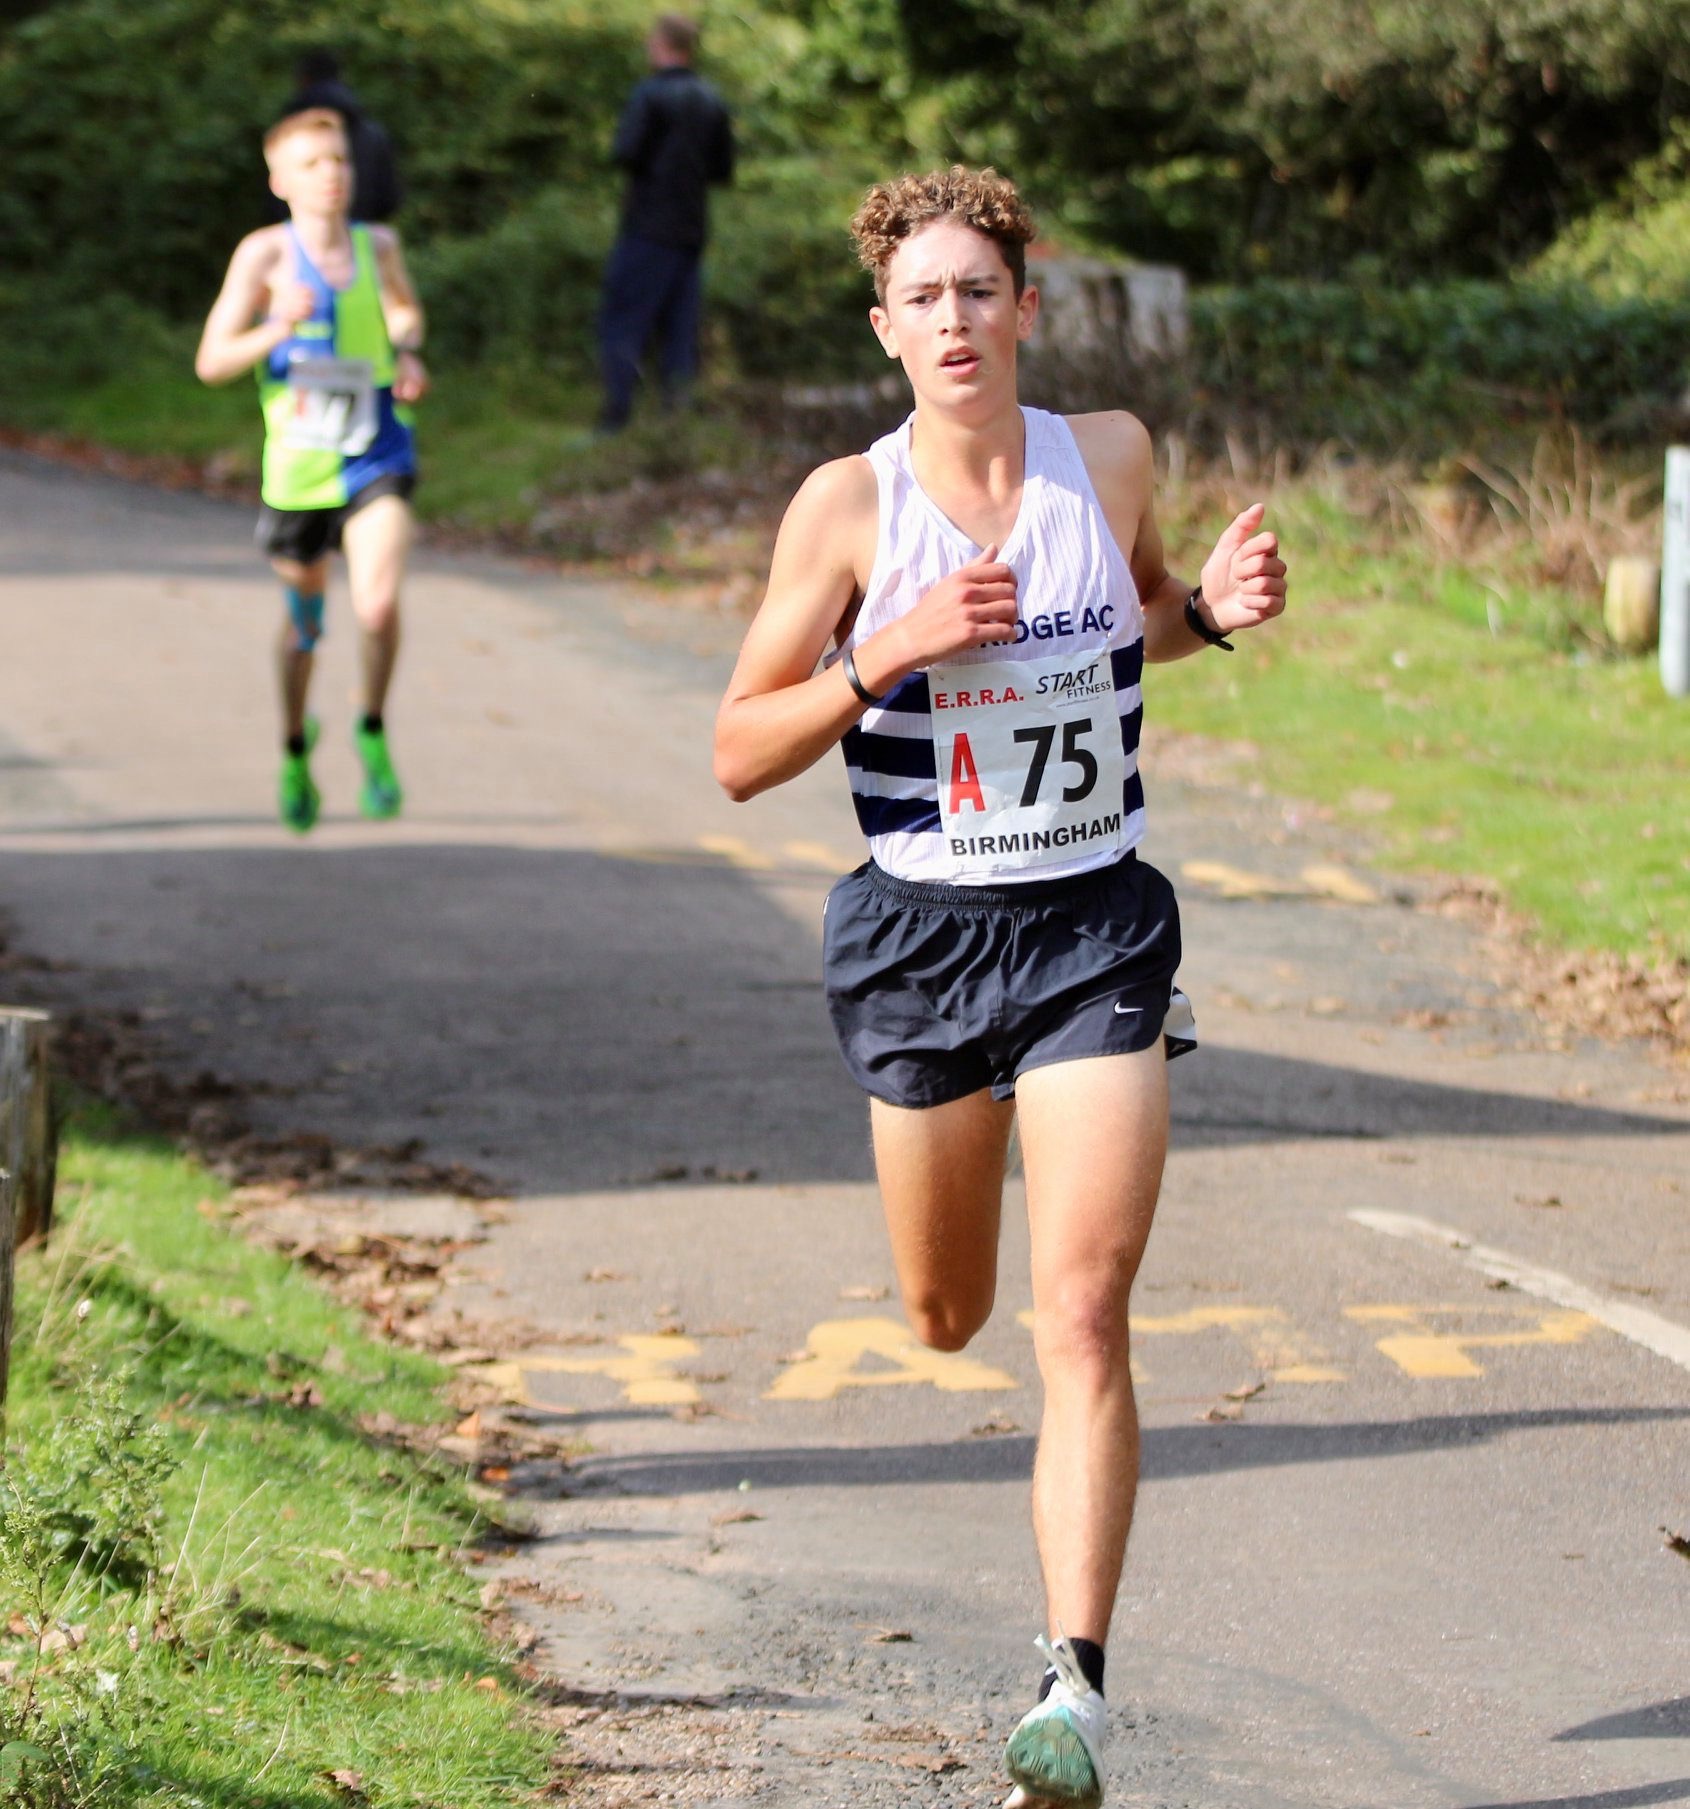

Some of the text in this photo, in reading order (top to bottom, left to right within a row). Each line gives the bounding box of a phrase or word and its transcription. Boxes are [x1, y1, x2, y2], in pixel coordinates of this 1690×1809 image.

[1081, 604, 1114, 634] AC
[1035, 664, 1099, 695] START
[1066, 680, 1112, 699] FITNESS
[935, 686, 1025, 710] E.R.R.A.
[949, 717, 1099, 814] A 75
[950, 813, 1121, 857] BIRMINGHAM
